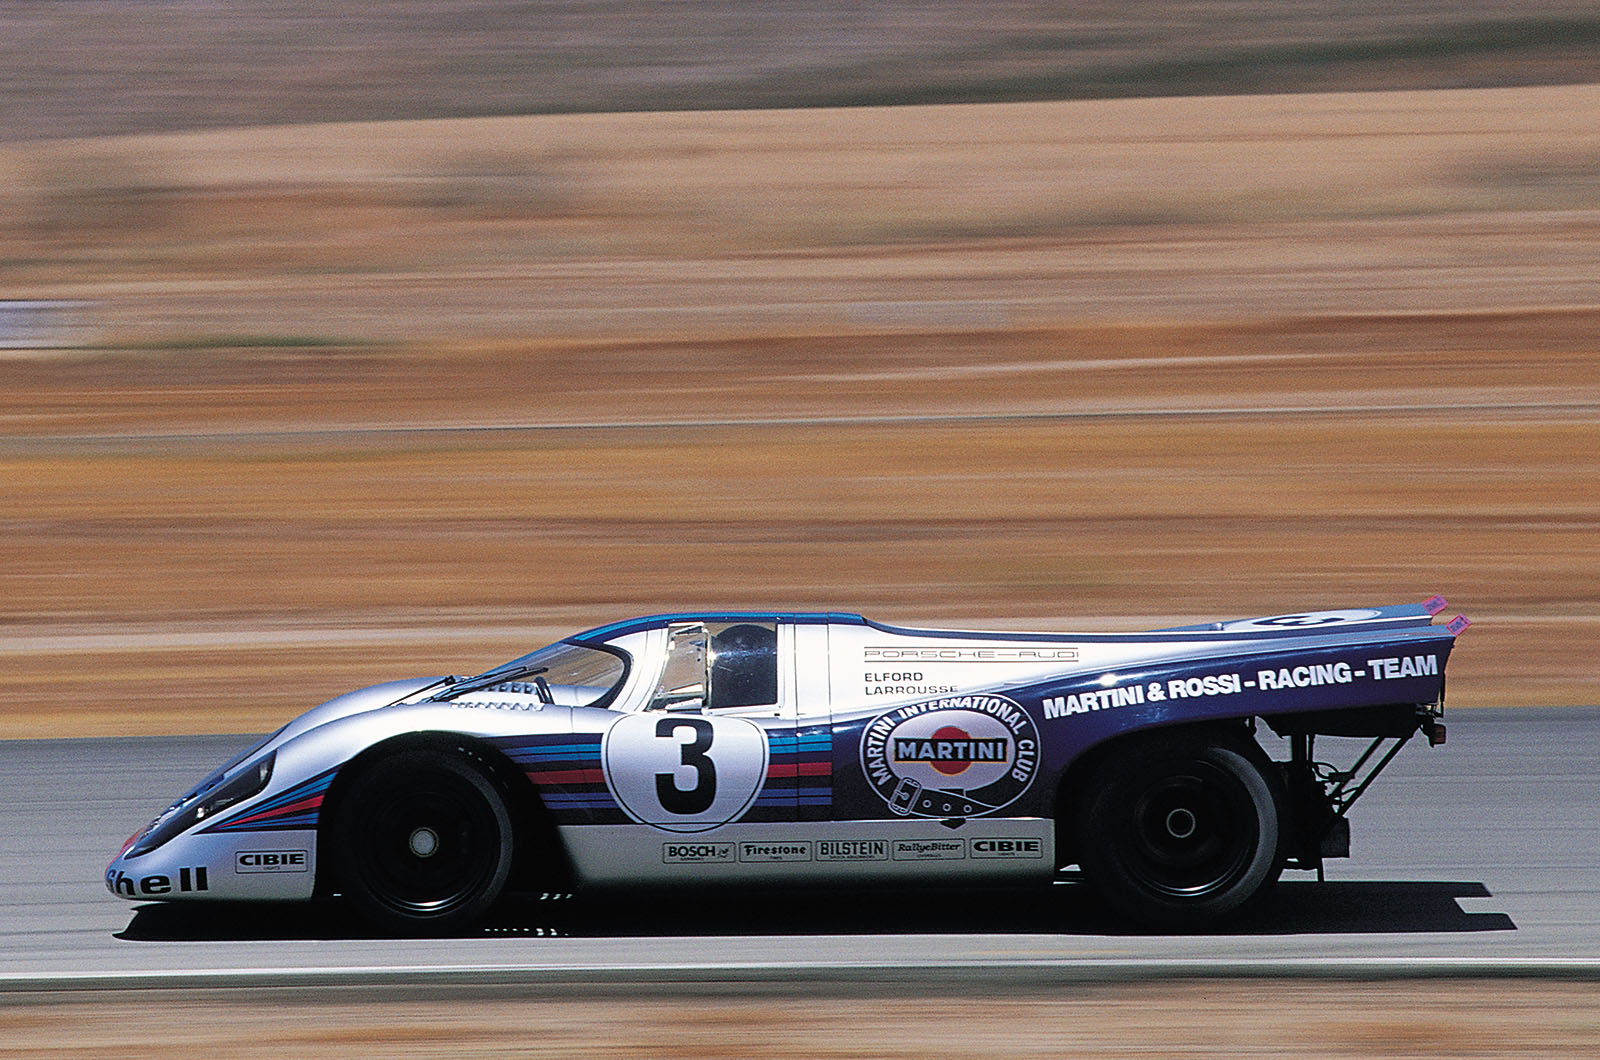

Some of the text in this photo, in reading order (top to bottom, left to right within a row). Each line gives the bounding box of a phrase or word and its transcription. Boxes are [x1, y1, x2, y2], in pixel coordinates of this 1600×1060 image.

[864, 672, 923, 682] ELFORD
[865, 685, 958, 696] LARROUSSE
[1042, 685, 1144, 720] MARTINI
[1147, 682, 1167, 702] &
[1168, 673, 1242, 700] ROSSI
[1367, 654, 1438, 680] TEAM
[867, 696, 1035, 786] MARTINI INTERNATIONAL CLUB
[898, 742, 1004, 760] MARTINI
[655, 718, 717, 814] 3
[668, 846, 715, 857] BOSCH
[744, 844, 807, 856] Firestone
[820, 842, 884, 855] BILSTEIN
[973, 841, 1039, 852] CIBIE
[239, 854, 305, 866] CIBIE
